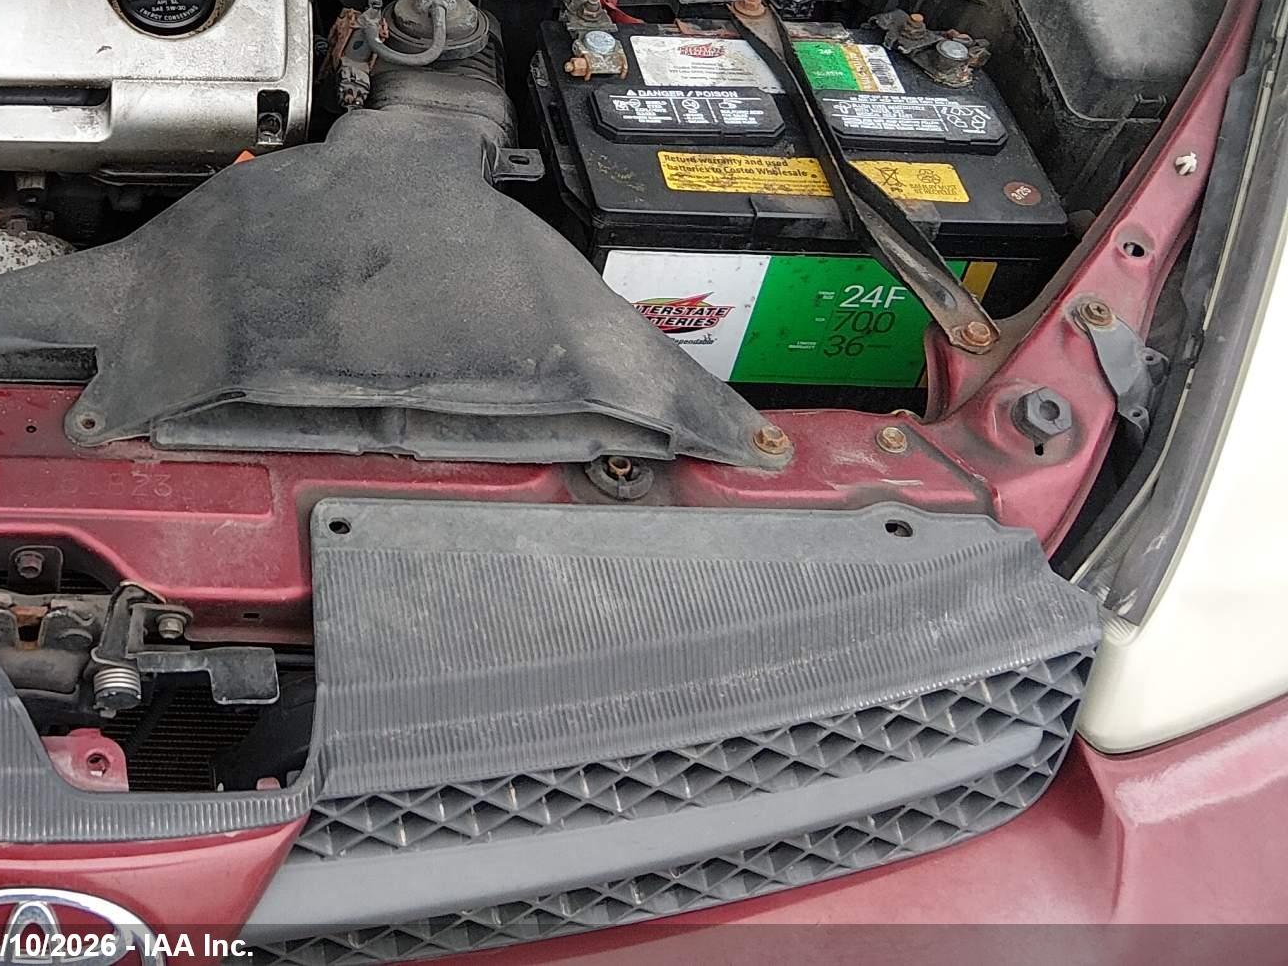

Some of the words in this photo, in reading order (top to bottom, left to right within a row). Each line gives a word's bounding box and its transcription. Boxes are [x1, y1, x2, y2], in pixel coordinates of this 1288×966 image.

[699, 157, 742, 166] warranty
[765, 159, 788, 167] used
[756, 168, 808, 177] Wholesale
[839, 285, 908, 309] 24F
[634, 305, 729, 317] TERSTATE
[832, 310, 897, 334] 700
[823, 335, 865, 357] 36
